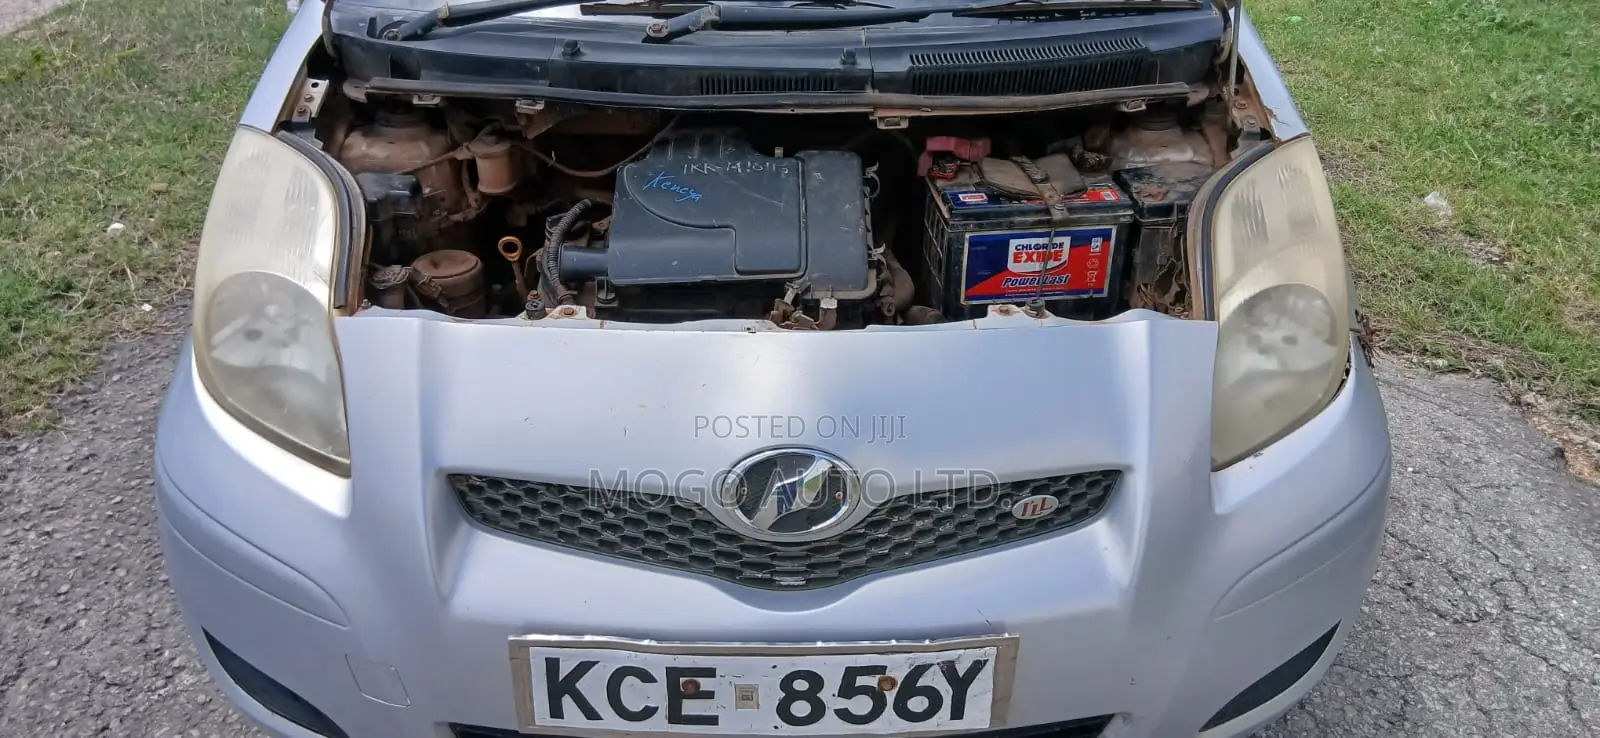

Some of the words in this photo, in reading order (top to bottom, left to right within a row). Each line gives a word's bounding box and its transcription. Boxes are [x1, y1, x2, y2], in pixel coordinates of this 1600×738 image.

[1014, 241, 1065, 251] CHLORDE
[544, 656, 720, 726] KCE
[775, 659, 990, 727] 856Y
